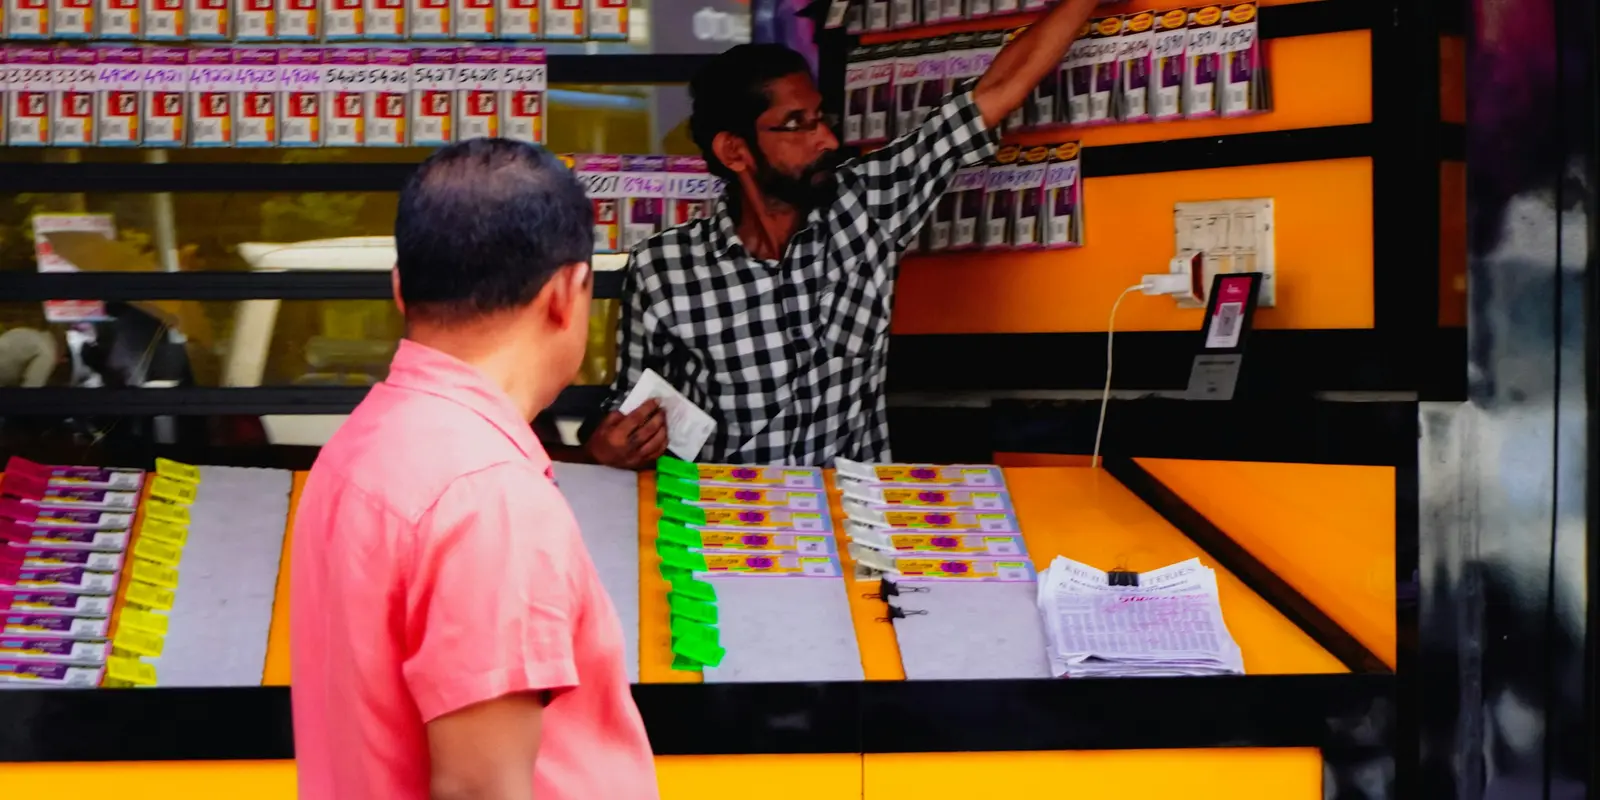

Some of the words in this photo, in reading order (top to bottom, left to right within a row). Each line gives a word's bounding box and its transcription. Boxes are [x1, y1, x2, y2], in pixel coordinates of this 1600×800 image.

[1156, 35, 1183, 53] 4890
[1188, 31, 1218, 50] 4891
[1220, 28, 1252, 48] 4892
[144, 68, 182, 84] 4921
[235, 68, 277, 84] 4923
[280, 68, 320, 85] 4924
[326, 67, 367, 83] 5425
[368, 67, 408, 84] 5426
[414, 67, 455, 83] 5427
[458, 67, 500, 83] 5428
[504, 67, 544, 83] 5429
[669, 178, 707, 194] 1155
